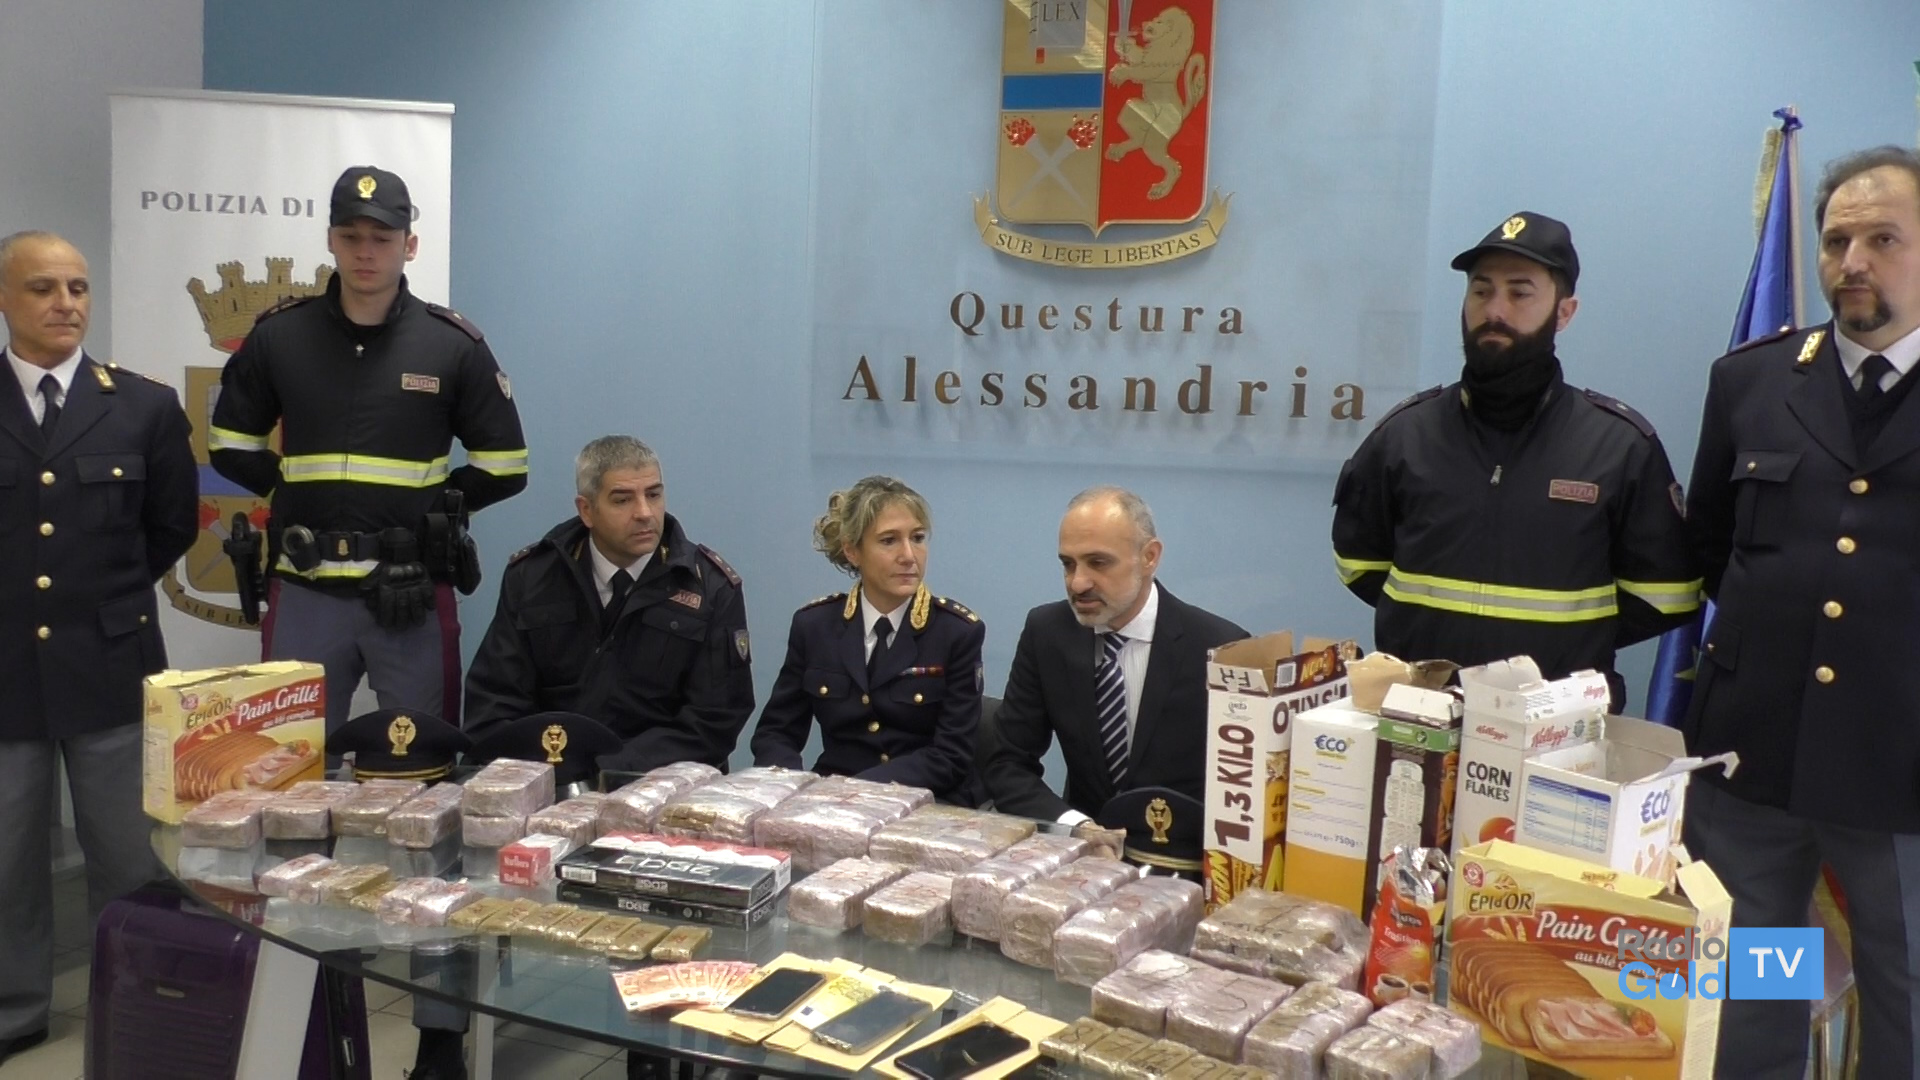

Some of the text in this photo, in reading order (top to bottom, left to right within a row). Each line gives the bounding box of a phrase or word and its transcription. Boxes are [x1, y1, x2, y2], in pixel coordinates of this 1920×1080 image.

[1042, 3, 1081, 22] LEX
[140, 190, 314, 218] POLIZIA DI
[995, 232, 1202, 265] SUB LEGE LIBERTAS
[949, 290, 1245, 336] Questura
[841, 354, 1367, 421] Alessandria
[1553, 482, 1594, 498] POLIZIA
[236, 683, 320, 726] Pain Grillé
[1216, 723, 1255, 788] KILO
[1465, 760, 1513, 789] CORN
[1464, 780, 1511, 803] FLAKES
[1214, 789, 1255, 848] 1,3
[1536, 910, 1596, 942] Pain
[1574, 951, 1594, 963] au
